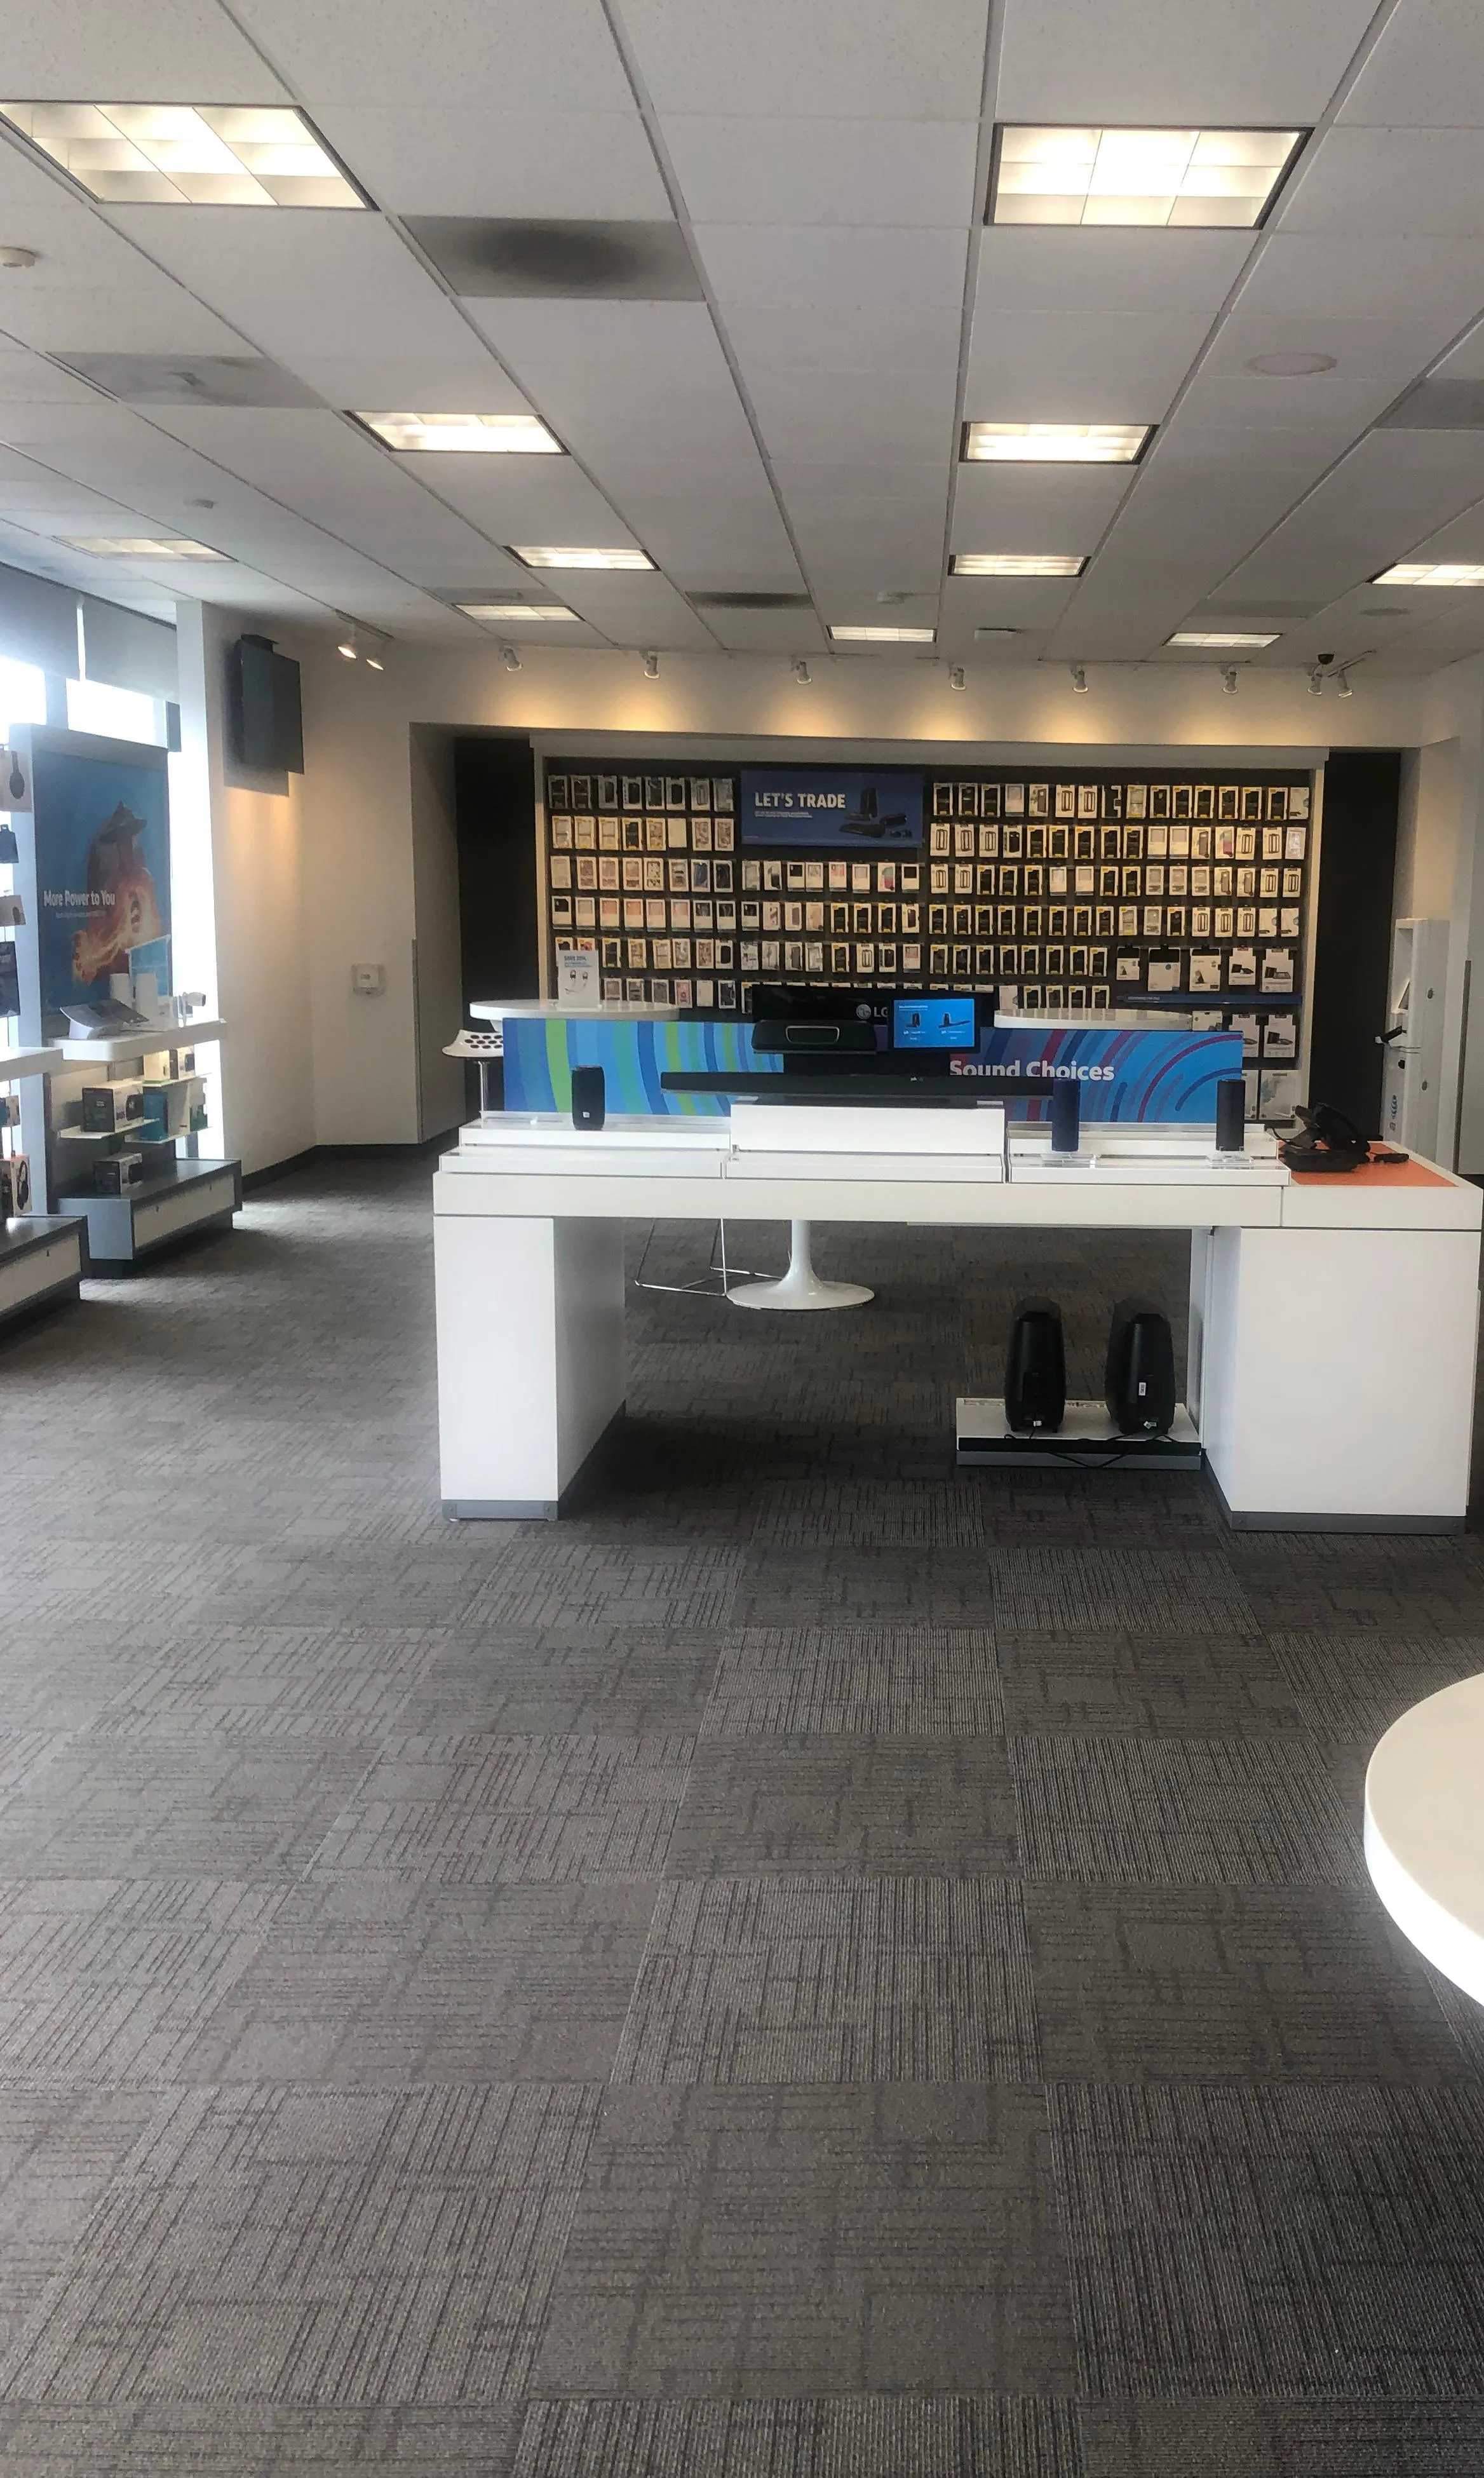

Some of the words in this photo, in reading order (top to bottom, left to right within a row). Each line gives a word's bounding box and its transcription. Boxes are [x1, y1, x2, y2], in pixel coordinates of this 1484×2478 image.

[755, 792, 793, 807] LET'S
[797, 793, 846, 809] TRADE
[43, 890, 63, 907] More
[65, 890, 90, 907] Power
[90, 891, 100, 905] to
[100, 890, 115, 905] You
[949, 1060, 1020, 1077] Sound
[1026, 1060, 1115, 1081] Choices
